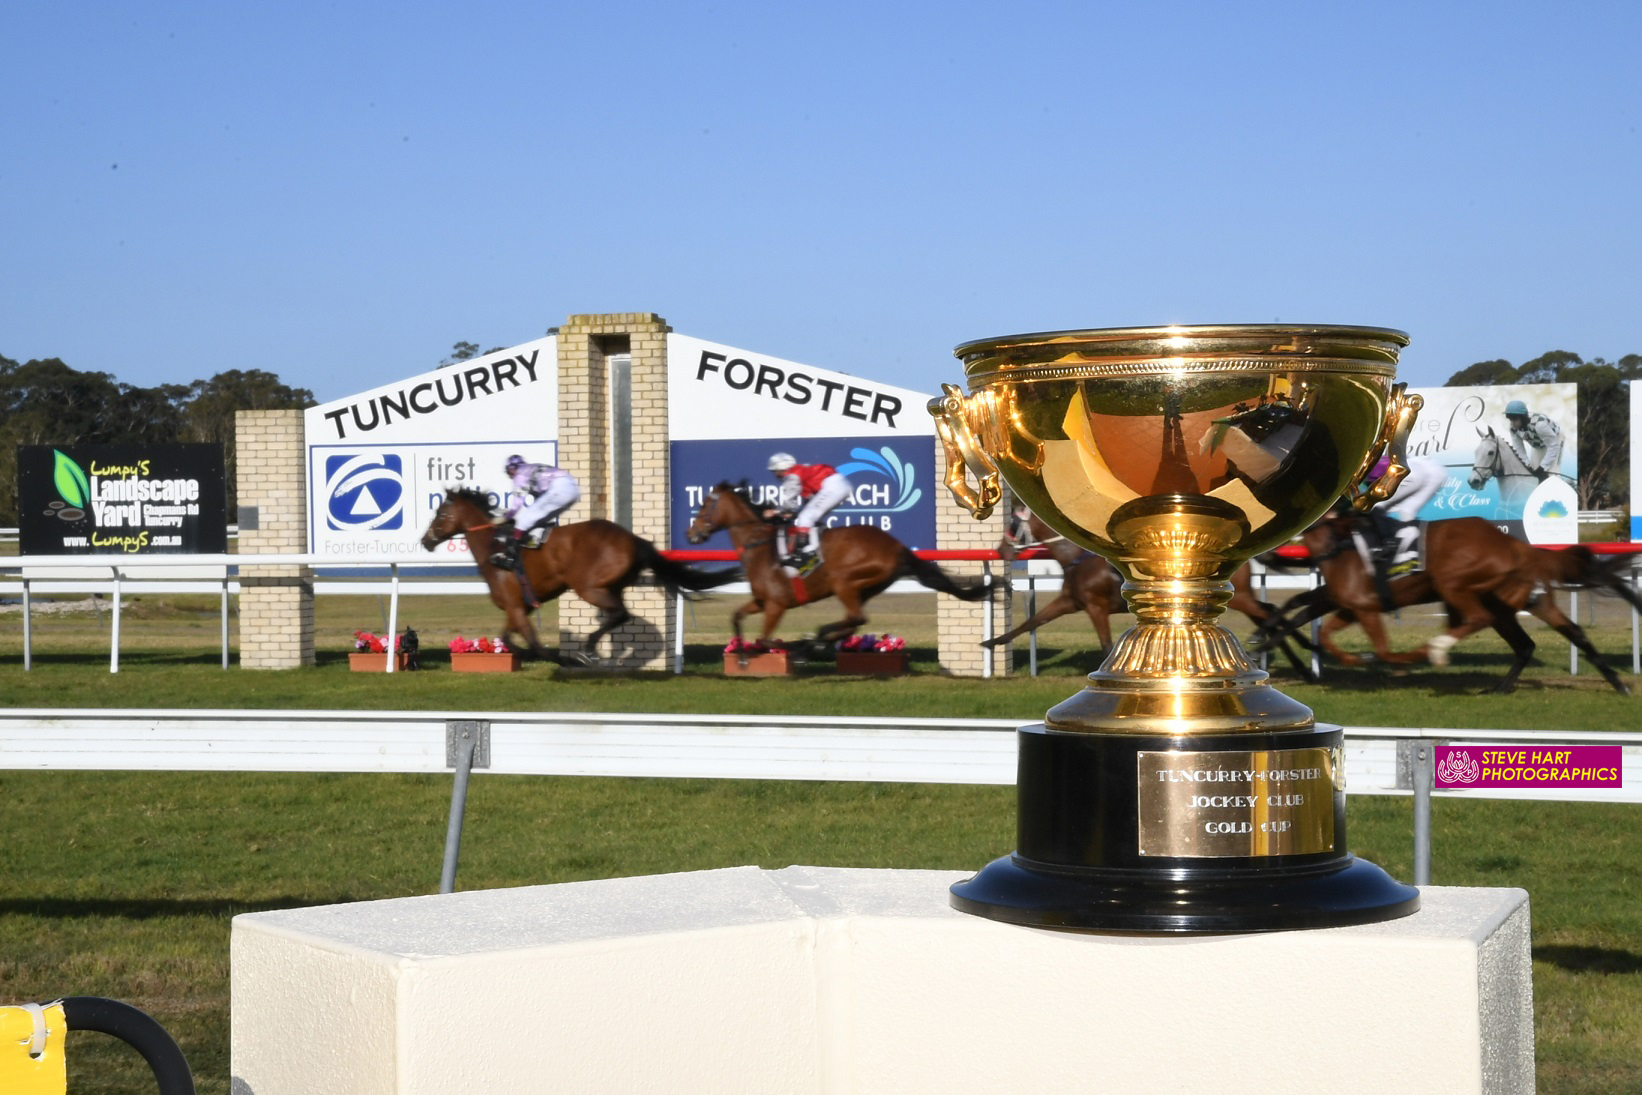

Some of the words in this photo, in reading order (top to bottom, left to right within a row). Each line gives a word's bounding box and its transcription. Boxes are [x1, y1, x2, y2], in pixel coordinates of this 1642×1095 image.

[324, 349, 540, 439] TUNCURRY
[696, 350, 902, 428] FORSTER
[1406, 396, 1485, 457] earl
[427, 457, 476, 480] first
[90, 476, 199, 504] Landscape
[91, 501, 141, 527] Yard
[325, 539, 424, 554] Forster-Tuncurr
[446, 539, 469, 552] 65
[1187, 795, 1259, 808] JOCKEY
[1267, 794, 1304, 807] CLUB
[1205, 822, 1252, 834] GOLD
[1260, 821, 1291, 833] CUP
